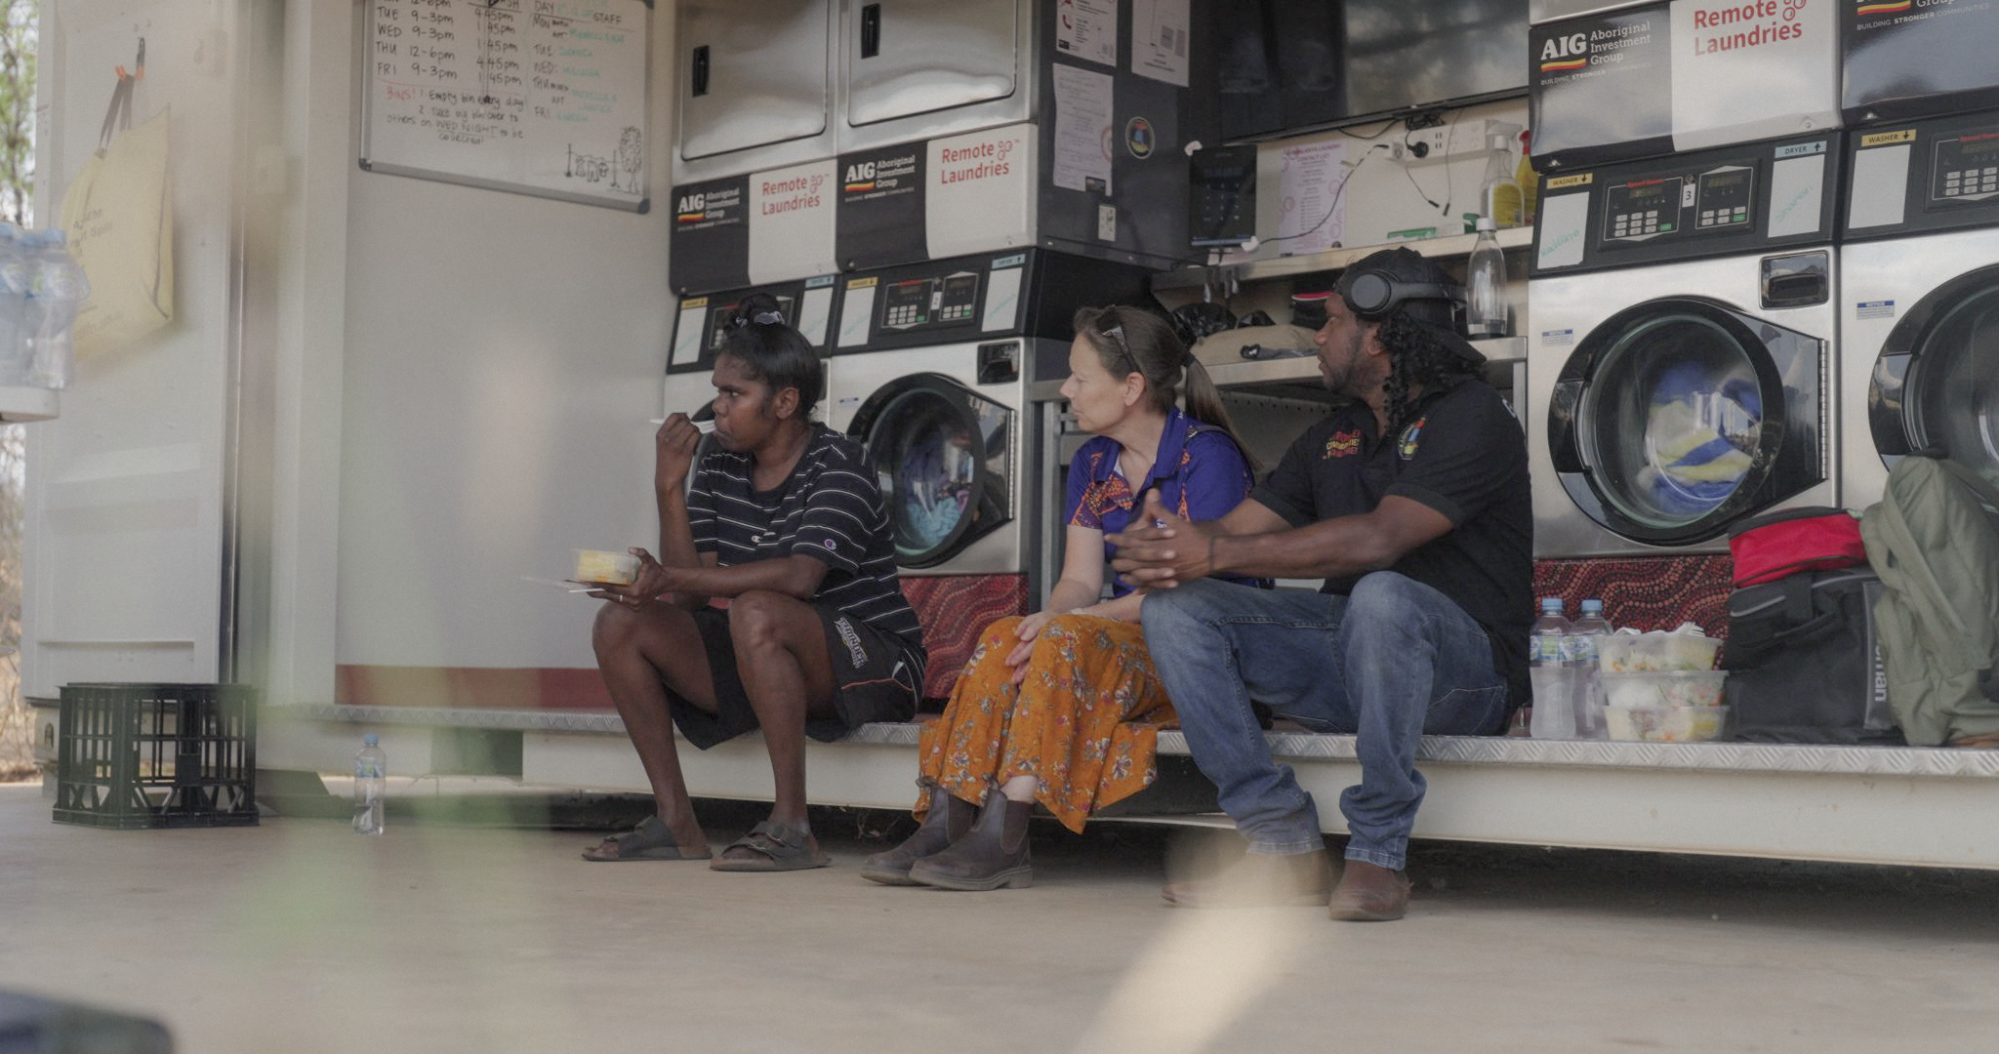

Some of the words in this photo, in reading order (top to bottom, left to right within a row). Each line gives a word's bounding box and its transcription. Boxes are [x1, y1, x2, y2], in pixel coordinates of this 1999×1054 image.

[377, 6, 398, 20] TUE
[593, 12, 622, 25] STAFF
[1694, 0, 1778, 29] Remote
[1857, 19, 1892, 31] BUILDING
[1894, 12, 1935, 24] STRONGER
[377, 23, 402, 38] WED
[1590, 21, 1651, 41] Aboriginal
[1590, 34, 1651, 53] Investment
[1694, 21, 1802, 56] Laundries
[376, 41, 397, 55] THU
[1540, 33, 1587, 60] AIG
[1590, 52, 1624, 66] Group
[377, 62, 397, 76] FRI
[462, 123, 499, 134] NIGHT
[1869, 133, 1899, 143] WASHER
[942, 143, 995, 163] Remote
[1785, 145, 1807, 155] DRYER
[877, 155, 916, 169] Aboriginal
[845, 162, 876, 182] AIG
[876, 165, 916, 178] Investment
[941, 161, 1010, 184] Laundries
[762, 178, 808, 196] Remote
[876, 178, 898, 189] Group
[1553, 177, 1578, 187] WASHER
[706, 187, 740, 200] Aboriginal
[1684, 190, 1692, 200] 3
[678, 193, 705, 213] AIG
[762, 194, 821, 215] Laundries
[705, 209, 725, 219] Group
